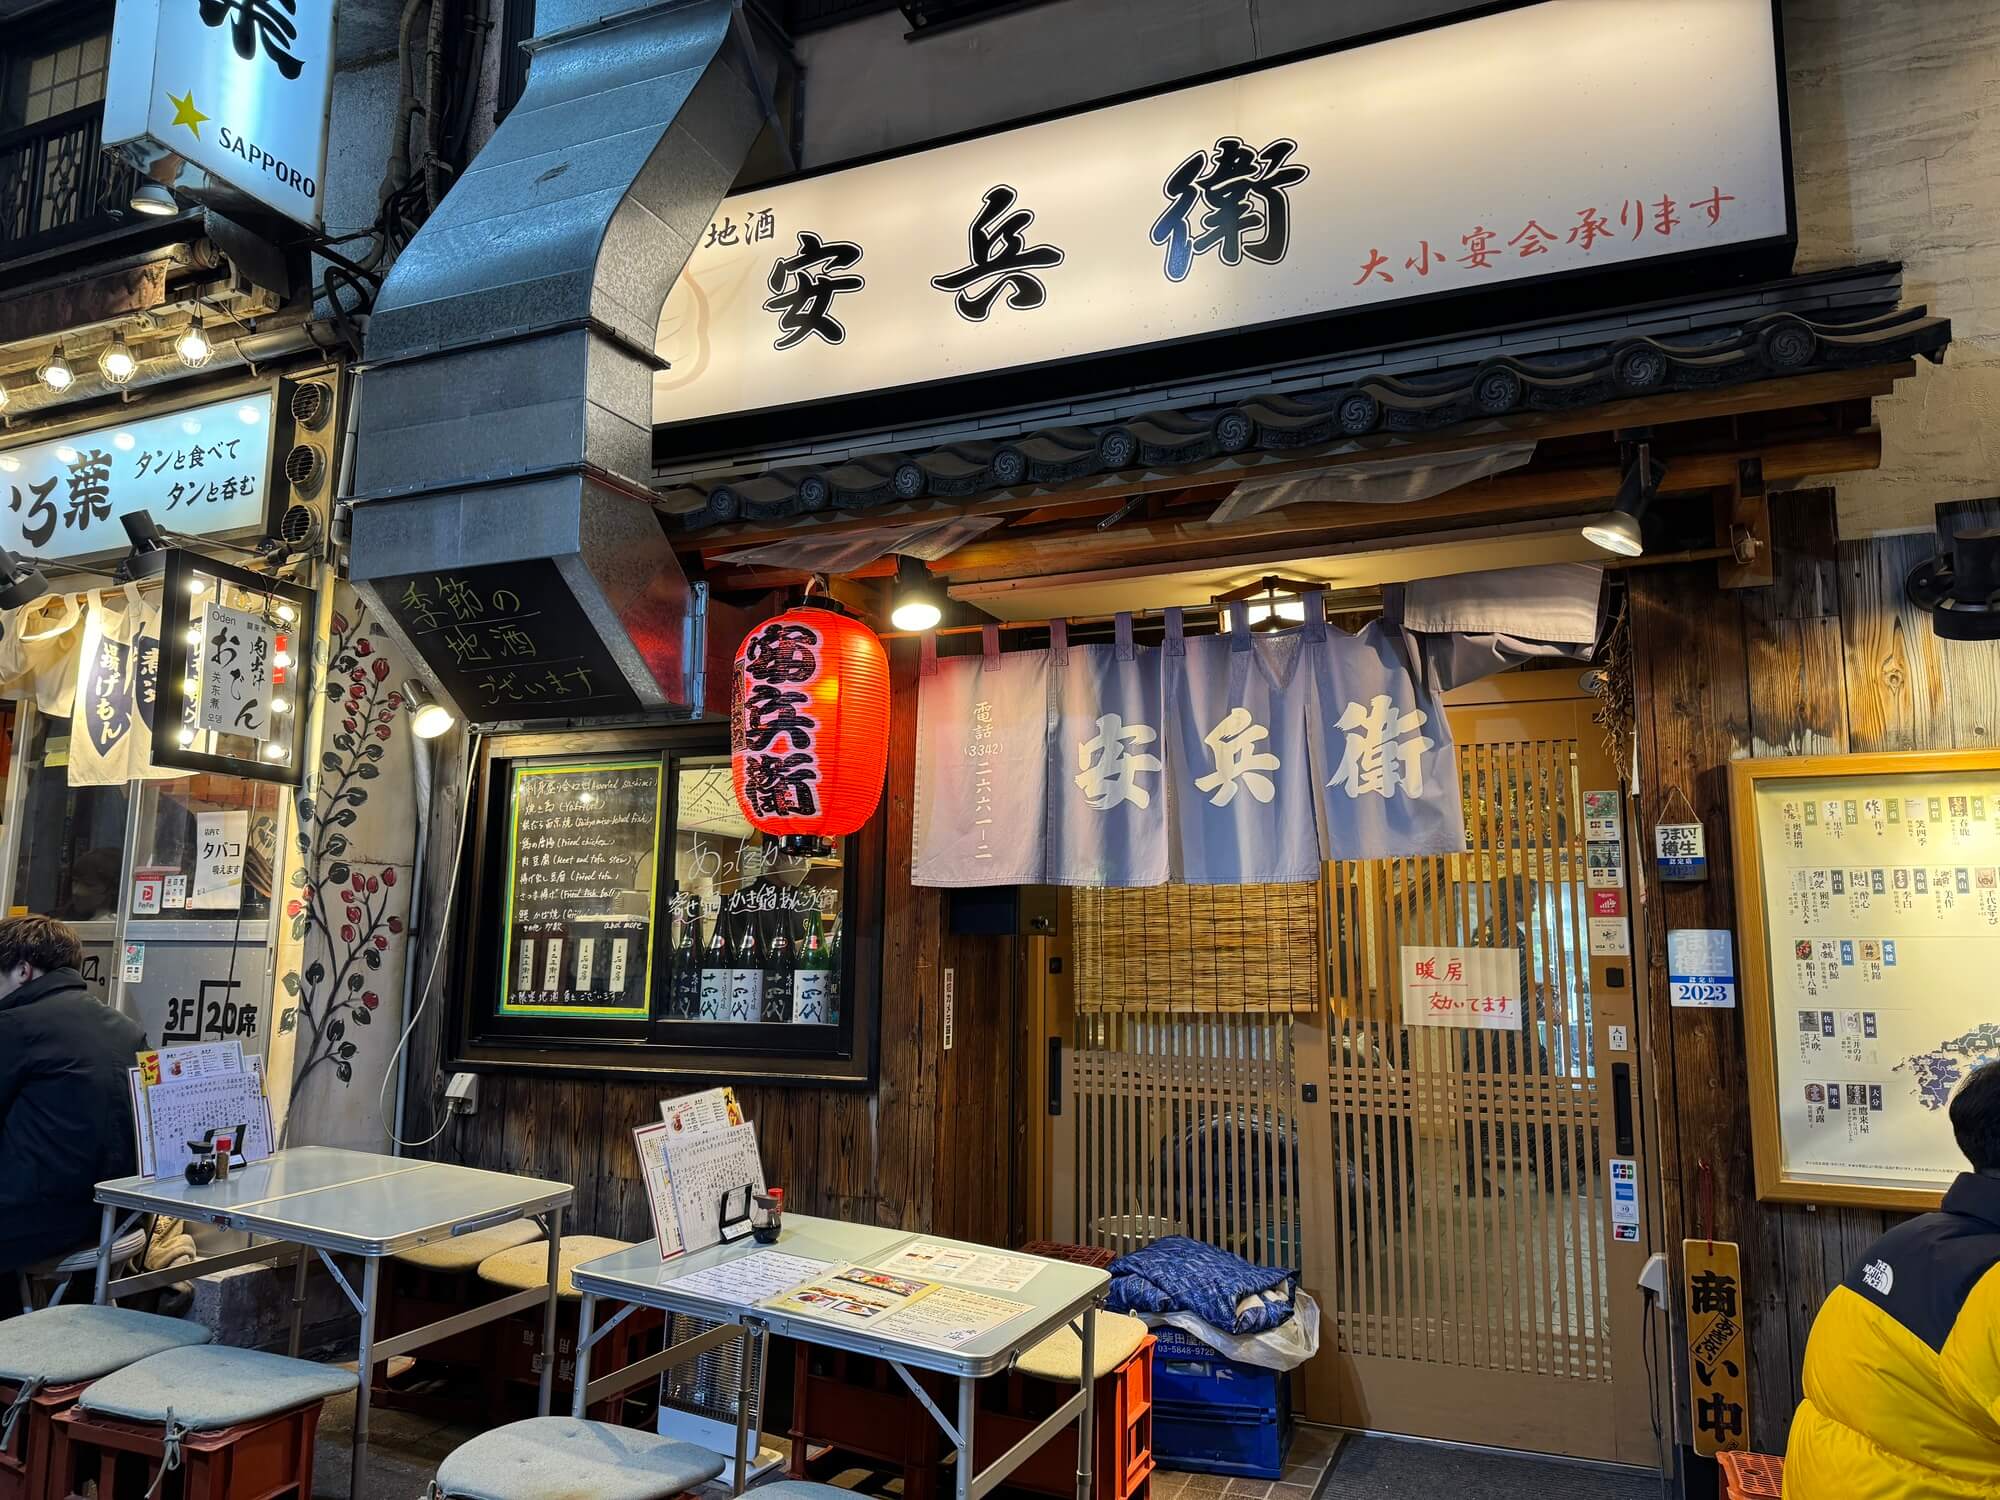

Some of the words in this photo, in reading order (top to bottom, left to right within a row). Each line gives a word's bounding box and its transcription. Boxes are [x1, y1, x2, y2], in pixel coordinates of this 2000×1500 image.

[217, 126, 316, 200] SAPPORO
[704, 209, 776, 249] 地酒
[762, 136, 1310, 352] 安兵衛
[1352, 185, 1735, 287] 大小宴会承ります
[134, 438, 241, 479] タンと食べて
[166, 474, 255, 511] タンと呑む
[212, 610, 236, 626] Oden
[401, 577, 521, 628] 季節の
[249, 636, 268, 691] 肉出汁
[445, 624, 537, 664] 地酒
[96, 643, 122, 744] 揚げもん
[210, 626, 264, 730] おでん
[479, 667, 593, 705] ございます
[746, 624, 817, 817] 安兵衛
[973, 701, 993, 740] 電話
[1073, 694, 1434, 810] 安兵衛
[203, 842, 241, 860] タバコ
[1660, 828, 1697, 840] うまい!
[1661, 841, 1698, 857] 樽生
[212, 865, 241, 876] 吸えます
[1832, 873, 1843, 890] 山口
[1414, 957, 1464, 981] 暖房
[701, 973, 719, 1020] 十四代
[731, 973, 750, 1021] 十四代
[799, 974, 823, 1022] 十四代
[1679, 984, 1728, 1001] 2023
[165, 997, 195, 1031] 3F
[205, 1001, 257, 1037] 20席
[1823, 1015, 1833, 1033] 佐賀
[1865, 1016, 1876, 1034] 福岡
[1829, 1087, 1839, 1105] 熊本
[1871, 1088, 1881, 1106] 大分
[1691, 1270, 1743, 1443] 商い中
